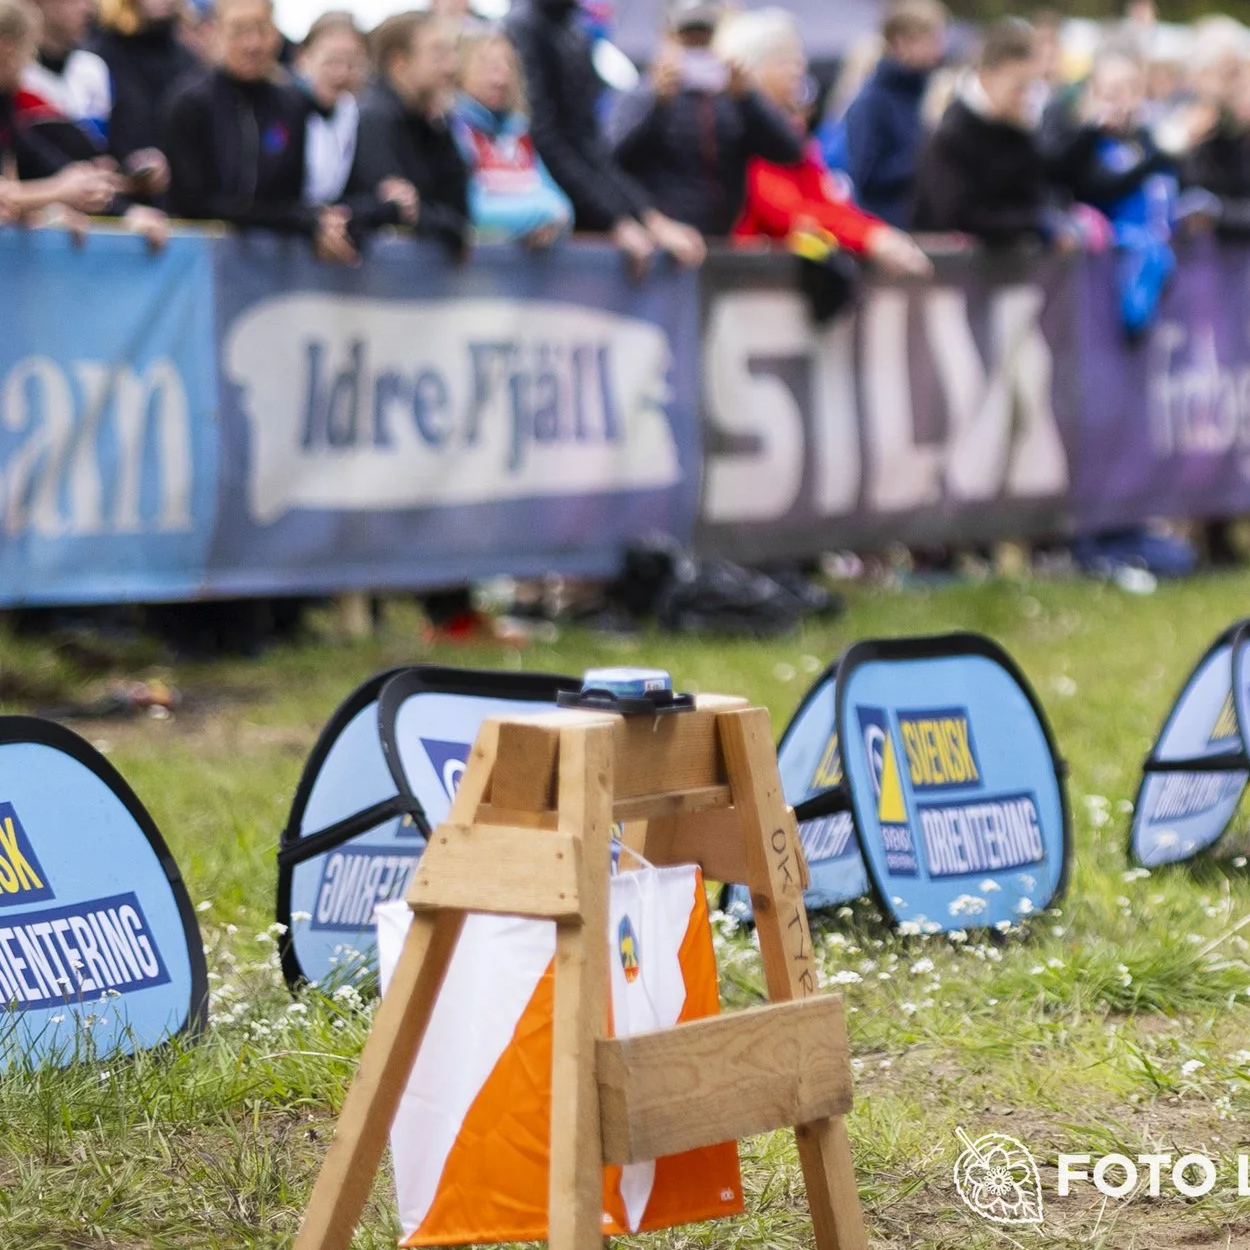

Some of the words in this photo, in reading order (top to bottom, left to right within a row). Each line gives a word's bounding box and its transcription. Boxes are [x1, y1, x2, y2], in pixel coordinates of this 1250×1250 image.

[901, 717, 980, 785] SVENSK
[770, 828, 794, 894] OK
[920, 796, 1045, 877] ORIENTERING
